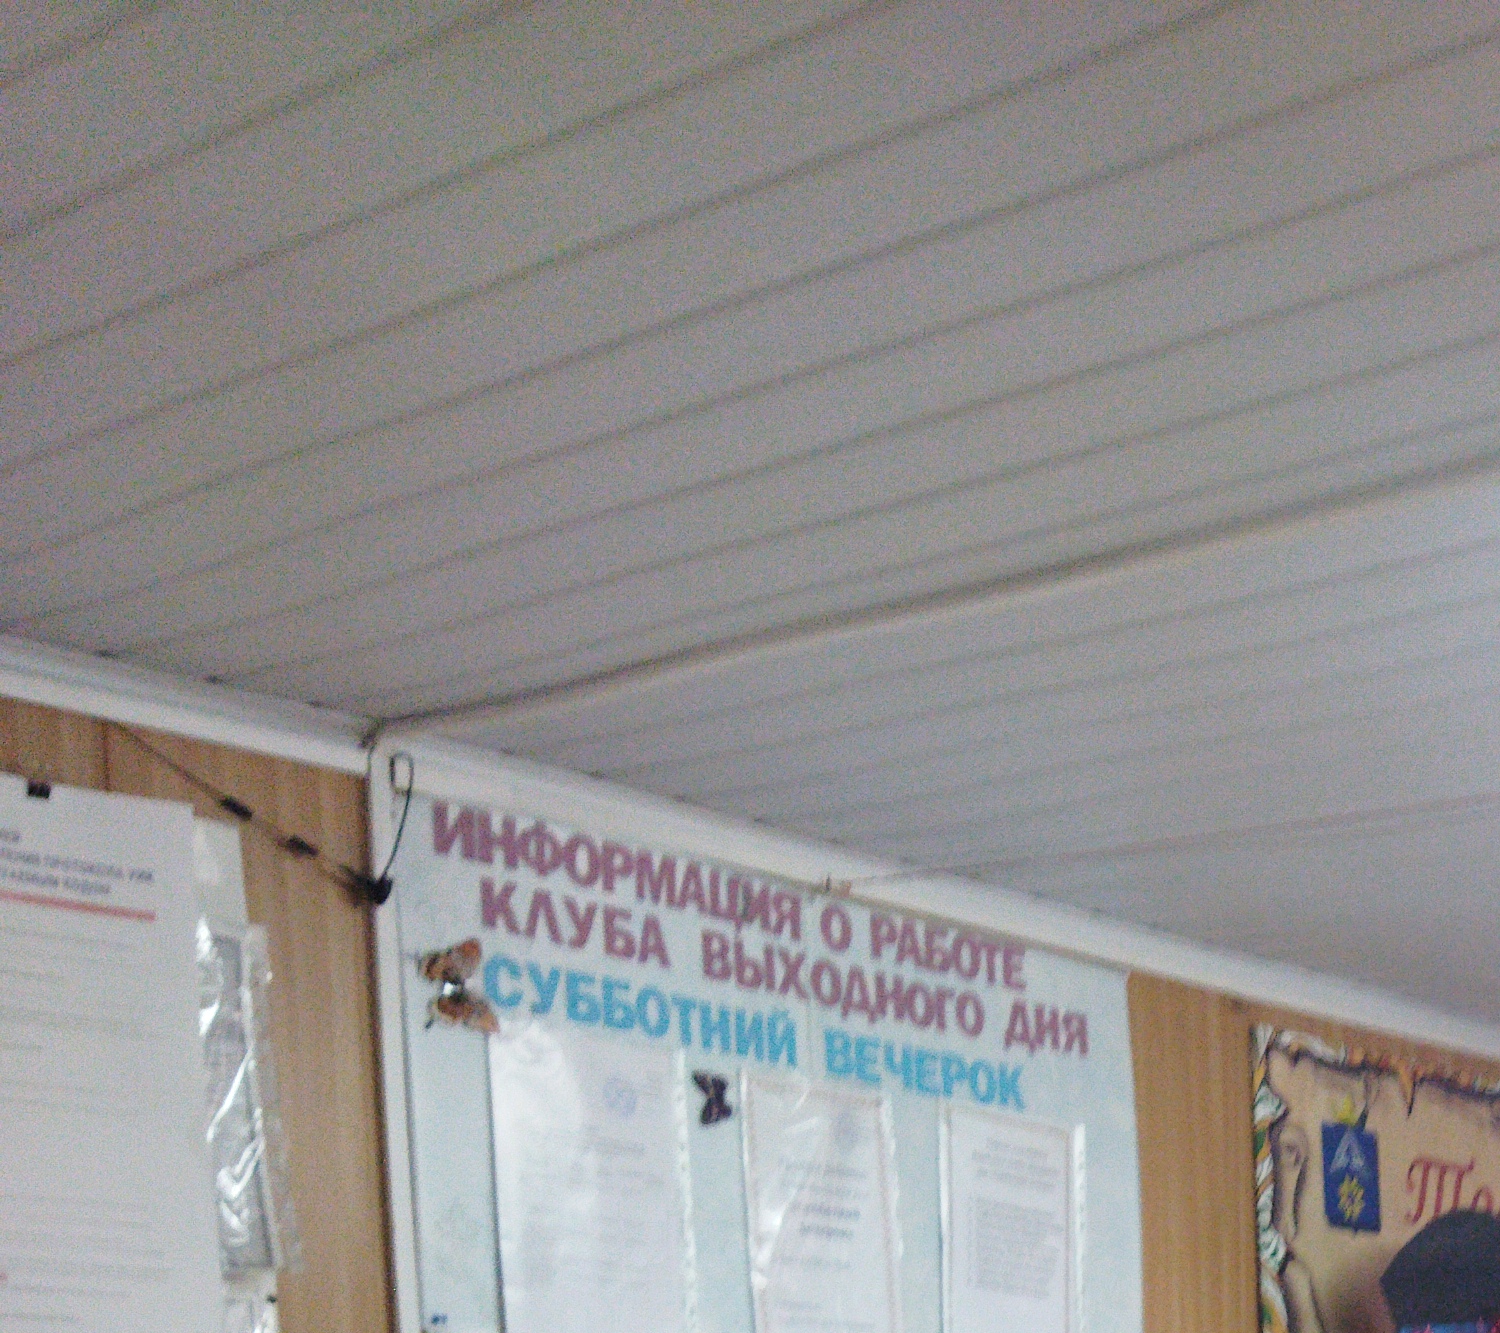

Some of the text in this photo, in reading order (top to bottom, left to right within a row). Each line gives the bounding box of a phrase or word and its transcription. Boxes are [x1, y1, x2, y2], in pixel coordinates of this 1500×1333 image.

[432, 801, 1027, 991] ИНФОРМАЦИЯ О РАБОТЕ
[479, 876, 1090, 1057] КЛУБА ВЫХОДНОГО ДНЯ
[484, 953, 1026, 1112] СУББОТНИЙ ВЕЧЕРОК
